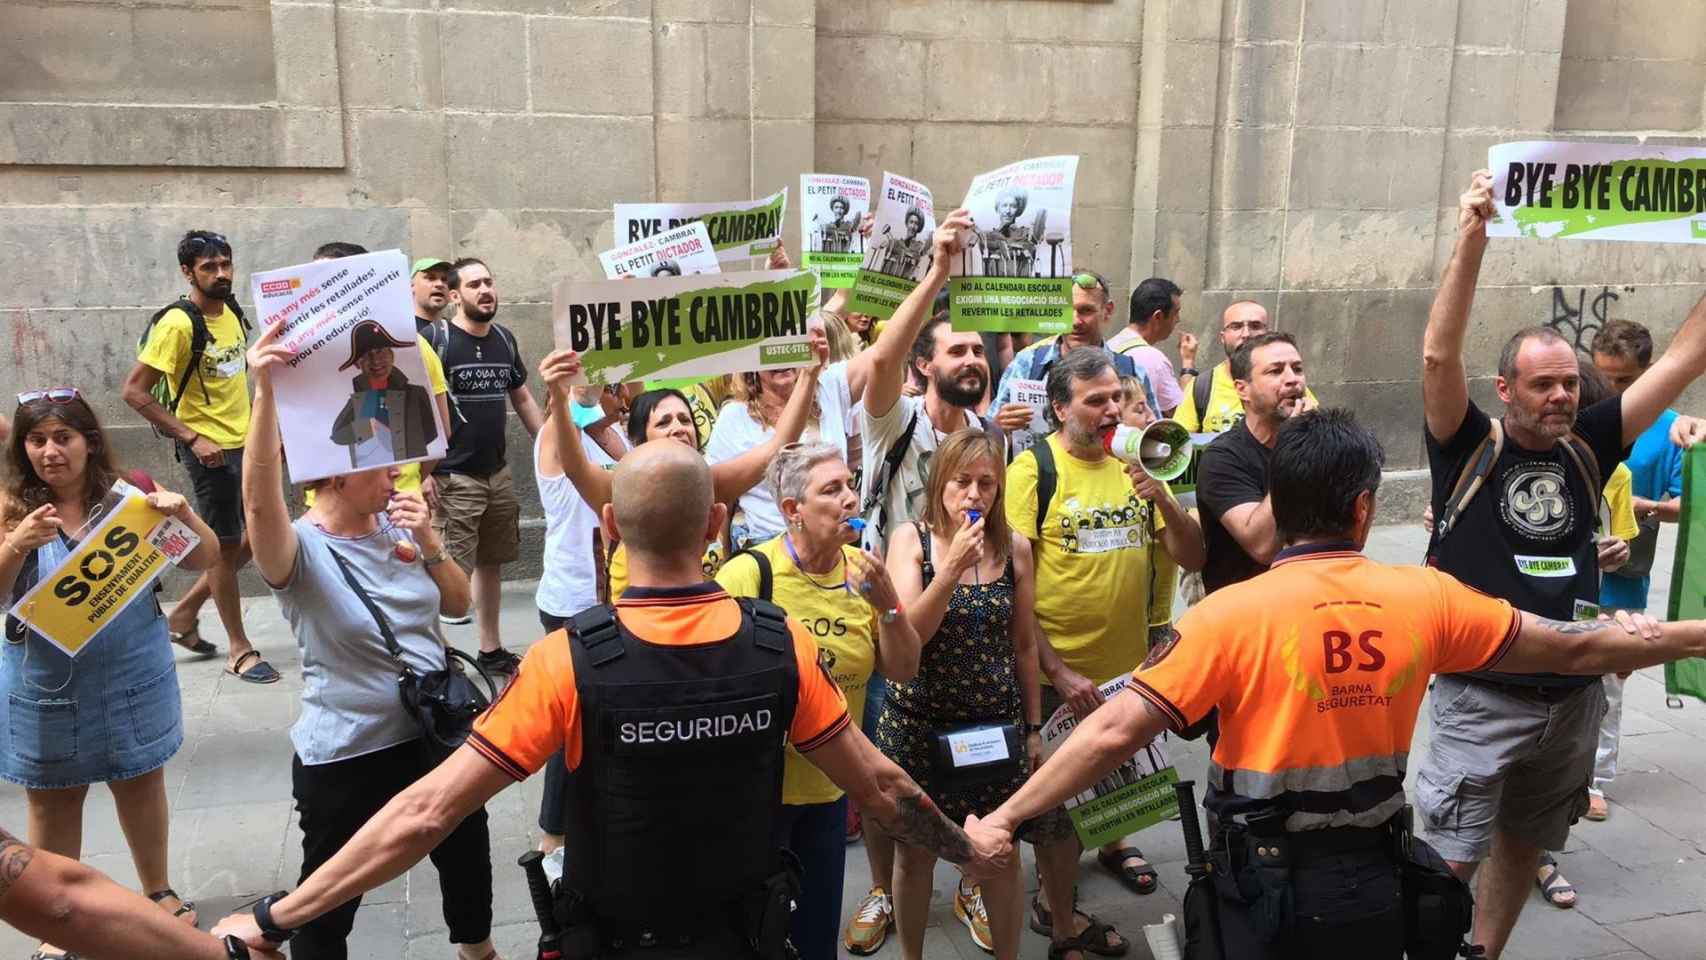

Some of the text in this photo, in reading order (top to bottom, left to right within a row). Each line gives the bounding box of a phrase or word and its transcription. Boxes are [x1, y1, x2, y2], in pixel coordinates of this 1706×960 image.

[817, 186, 837, 195] PETIT
[887, 188, 896, 200] EL
[896, 191, 915, 205] PETIT
[1504, 162, 1557, 208] BYE
[1562, 164, 1613, 210] BYE
[708, 206, 782, 246] CAMBRAY
[615, 263, 628, 275] EL
[628, 253, 655, 271] PETIT
[656, 238, 703, 260] DICTADOR
[264, 268, 349, 326] Un any més sense
[275, 268, 376, 340] revertir les retallades!
[337, 294, 363, 315] sense
[365, 270, 401, 298] invertir
[961, 282, 1062, 292] NO AL CALENDARI ESCOLAR
[984, 295, 999, 304] UNA
[1048, 296, 1068, 305] REAL
[312, 338, 325, 351] en
[326, 306, 370, 342] educació!
[569, 289, 809, 352] BYE BYE CAMBRAY
[962, 307, 1063, 317] REVERTIM LES RETALLADES
[1017, 392, 1027, 402] EL
[54, 526, 140, 607] SOS
[88, 552, 144, 607] ENSENYAMENT
[116, 584, 129, 597] DE
[127, 550, 160, 586] QUALITAT
[801, 616, 848, 637] SOS
[1322, 630, 1386, 674] BS
[1101, 679, 1125, 698] BRAY
[1332, 684, 1373, 696] BARNA
[620, 708, 772, 744] SEGURIDAD
